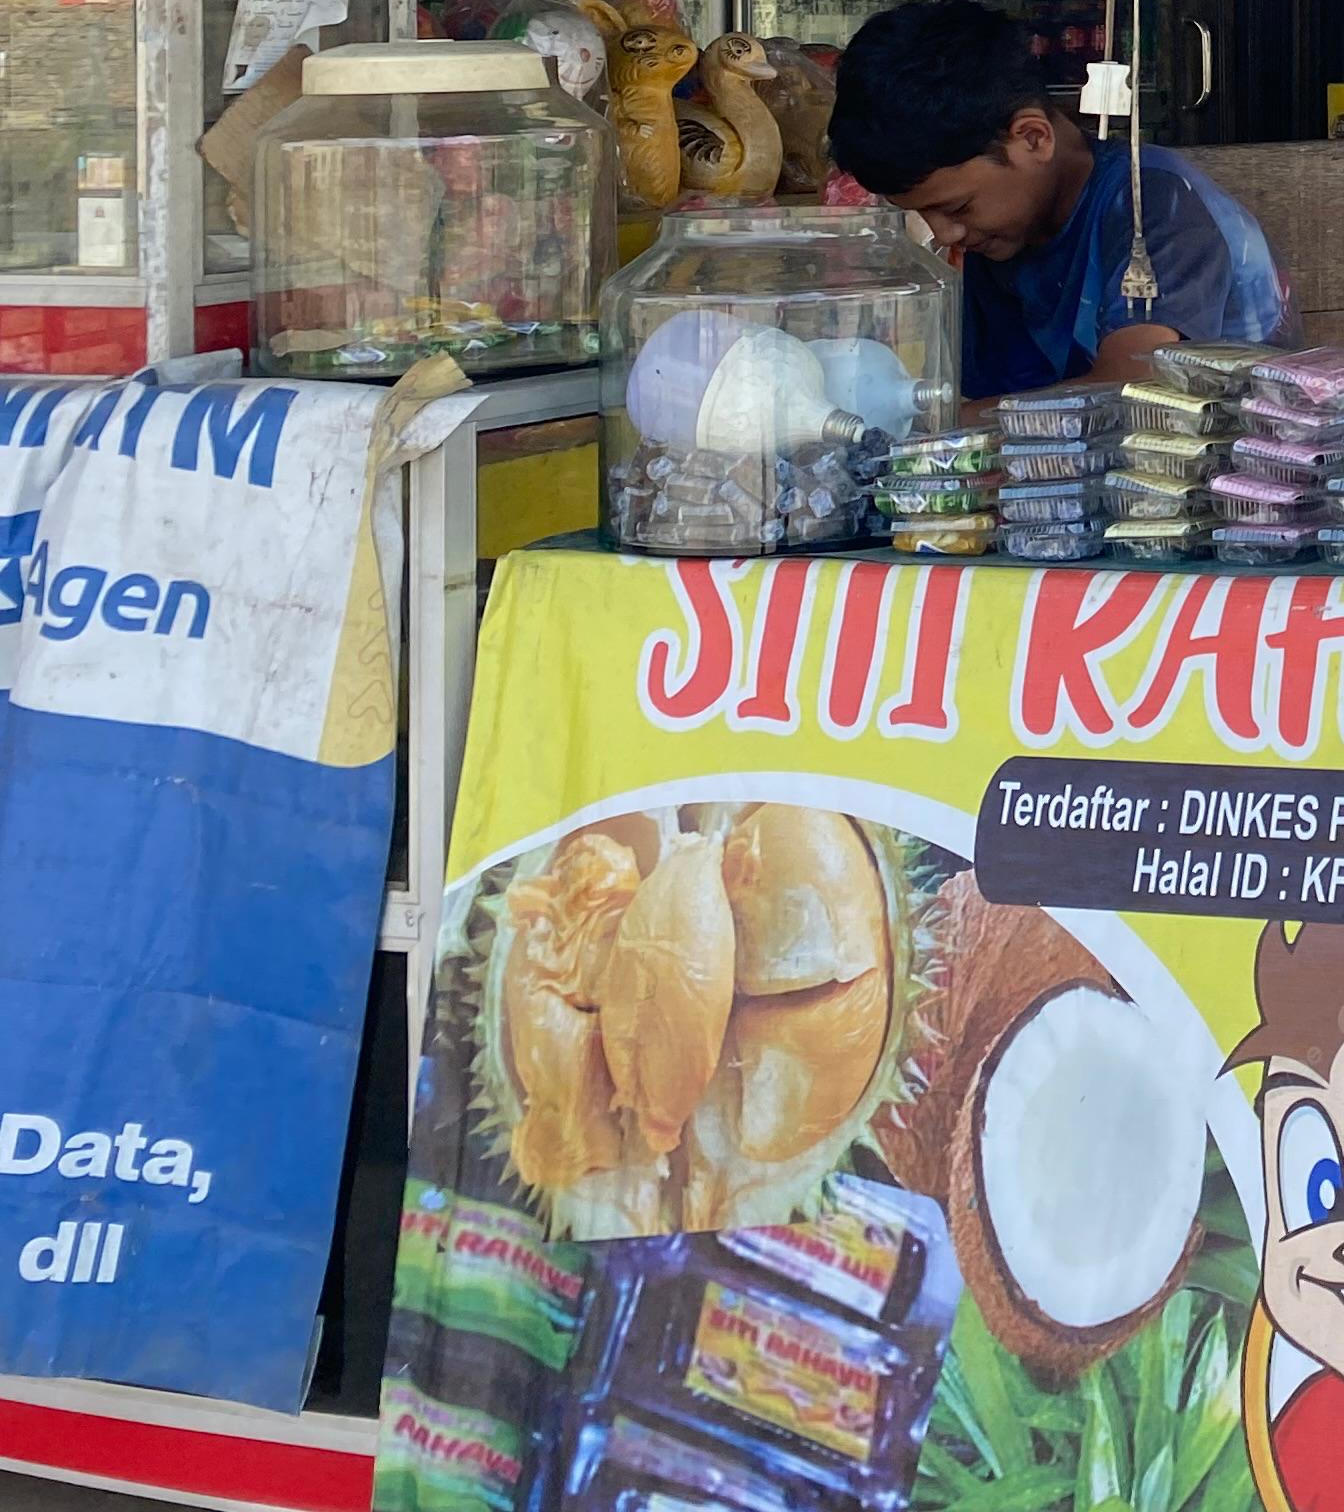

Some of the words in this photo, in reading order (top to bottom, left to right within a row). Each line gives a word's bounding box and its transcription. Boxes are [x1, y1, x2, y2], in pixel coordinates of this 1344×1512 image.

[999, 780, 1149, 832] Terdaftar
[1179, 789, 1318, 842] DINKES
[1133, 847, 1225, 899] Halal
[1231, 854, 1268, 901] ID
[0, 1112, 212, 1204] Data,
[18, 1220, 126, 1285] dll
